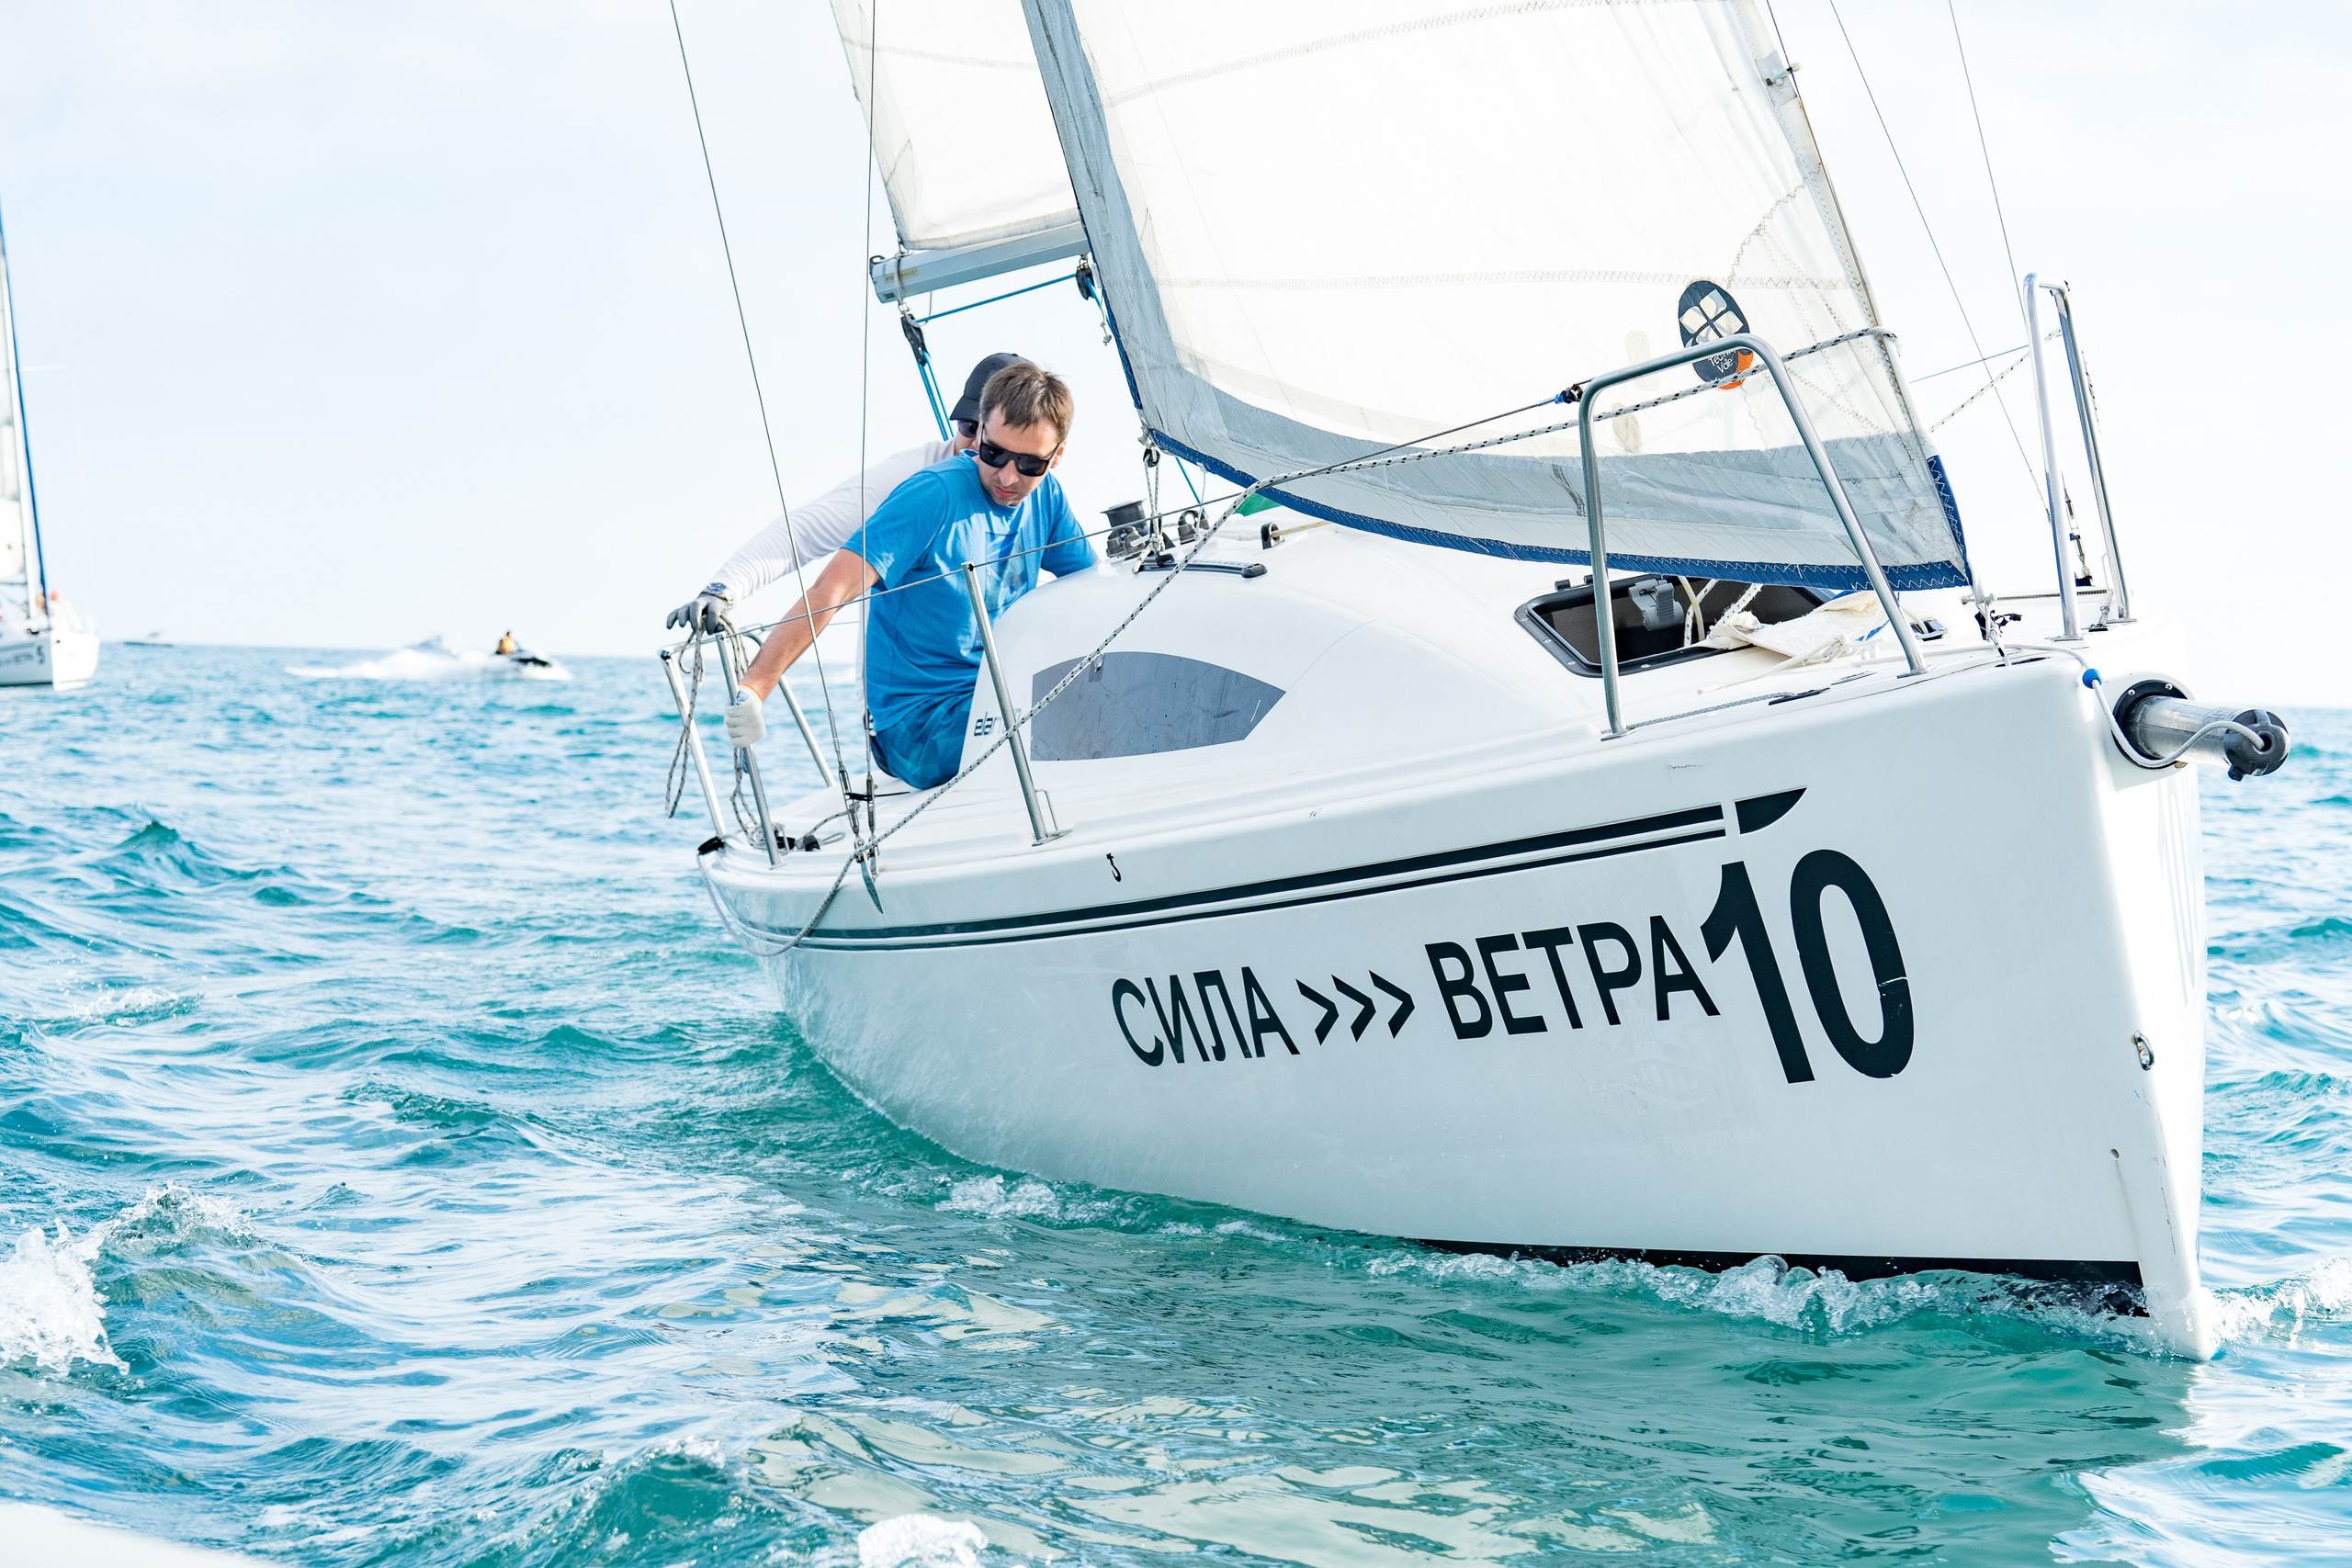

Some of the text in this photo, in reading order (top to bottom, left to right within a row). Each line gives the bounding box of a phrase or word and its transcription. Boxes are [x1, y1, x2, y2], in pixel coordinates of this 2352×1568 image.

[1112, 914, 1722, 1067] СИЛА ВЕТРА
[1700, 848, 1915, 1085] 10
